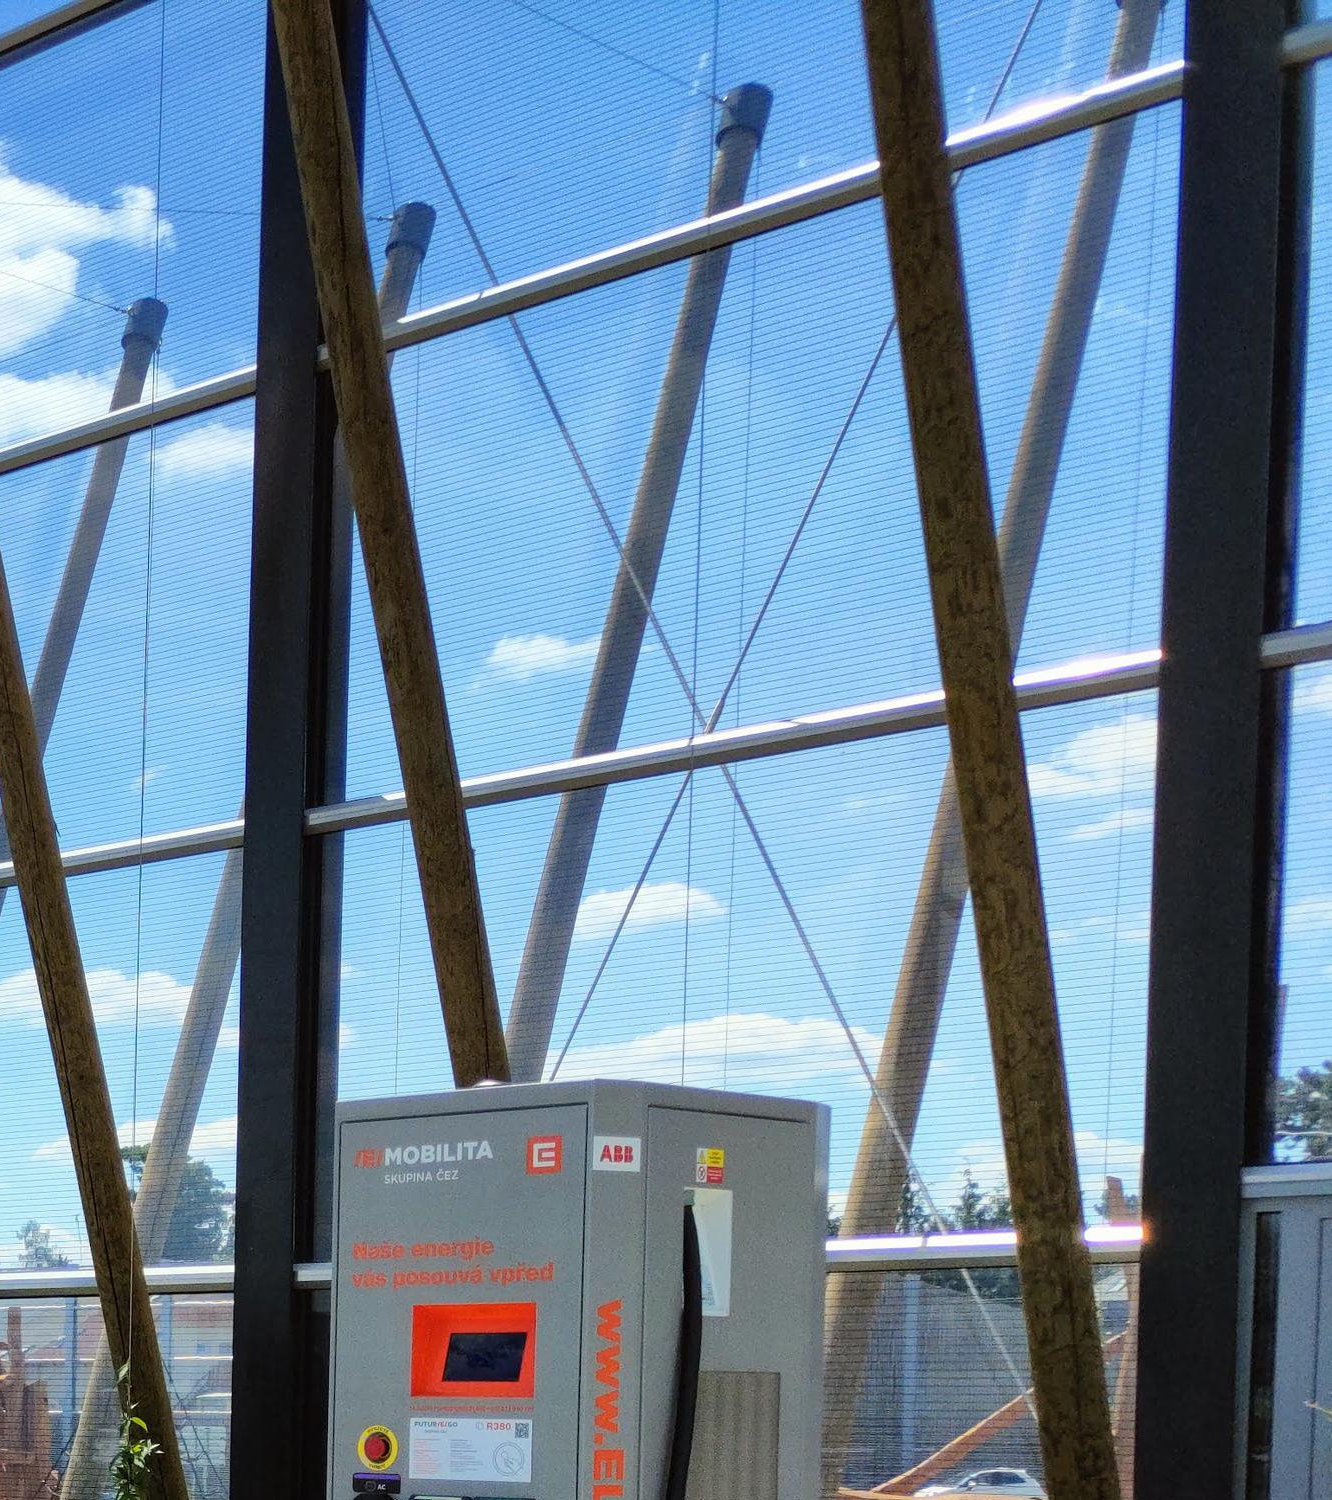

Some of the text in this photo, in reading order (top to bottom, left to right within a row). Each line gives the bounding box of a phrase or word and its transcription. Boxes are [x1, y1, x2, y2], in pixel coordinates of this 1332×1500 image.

[599, 1144, 635, 1163] ABB
[384, 1168, 459, 1185] SKUPINA ČEZ
[410, 1236, 495, 1261] energie
[352, 1261, 554, 1291] vás posouvá vpřed
